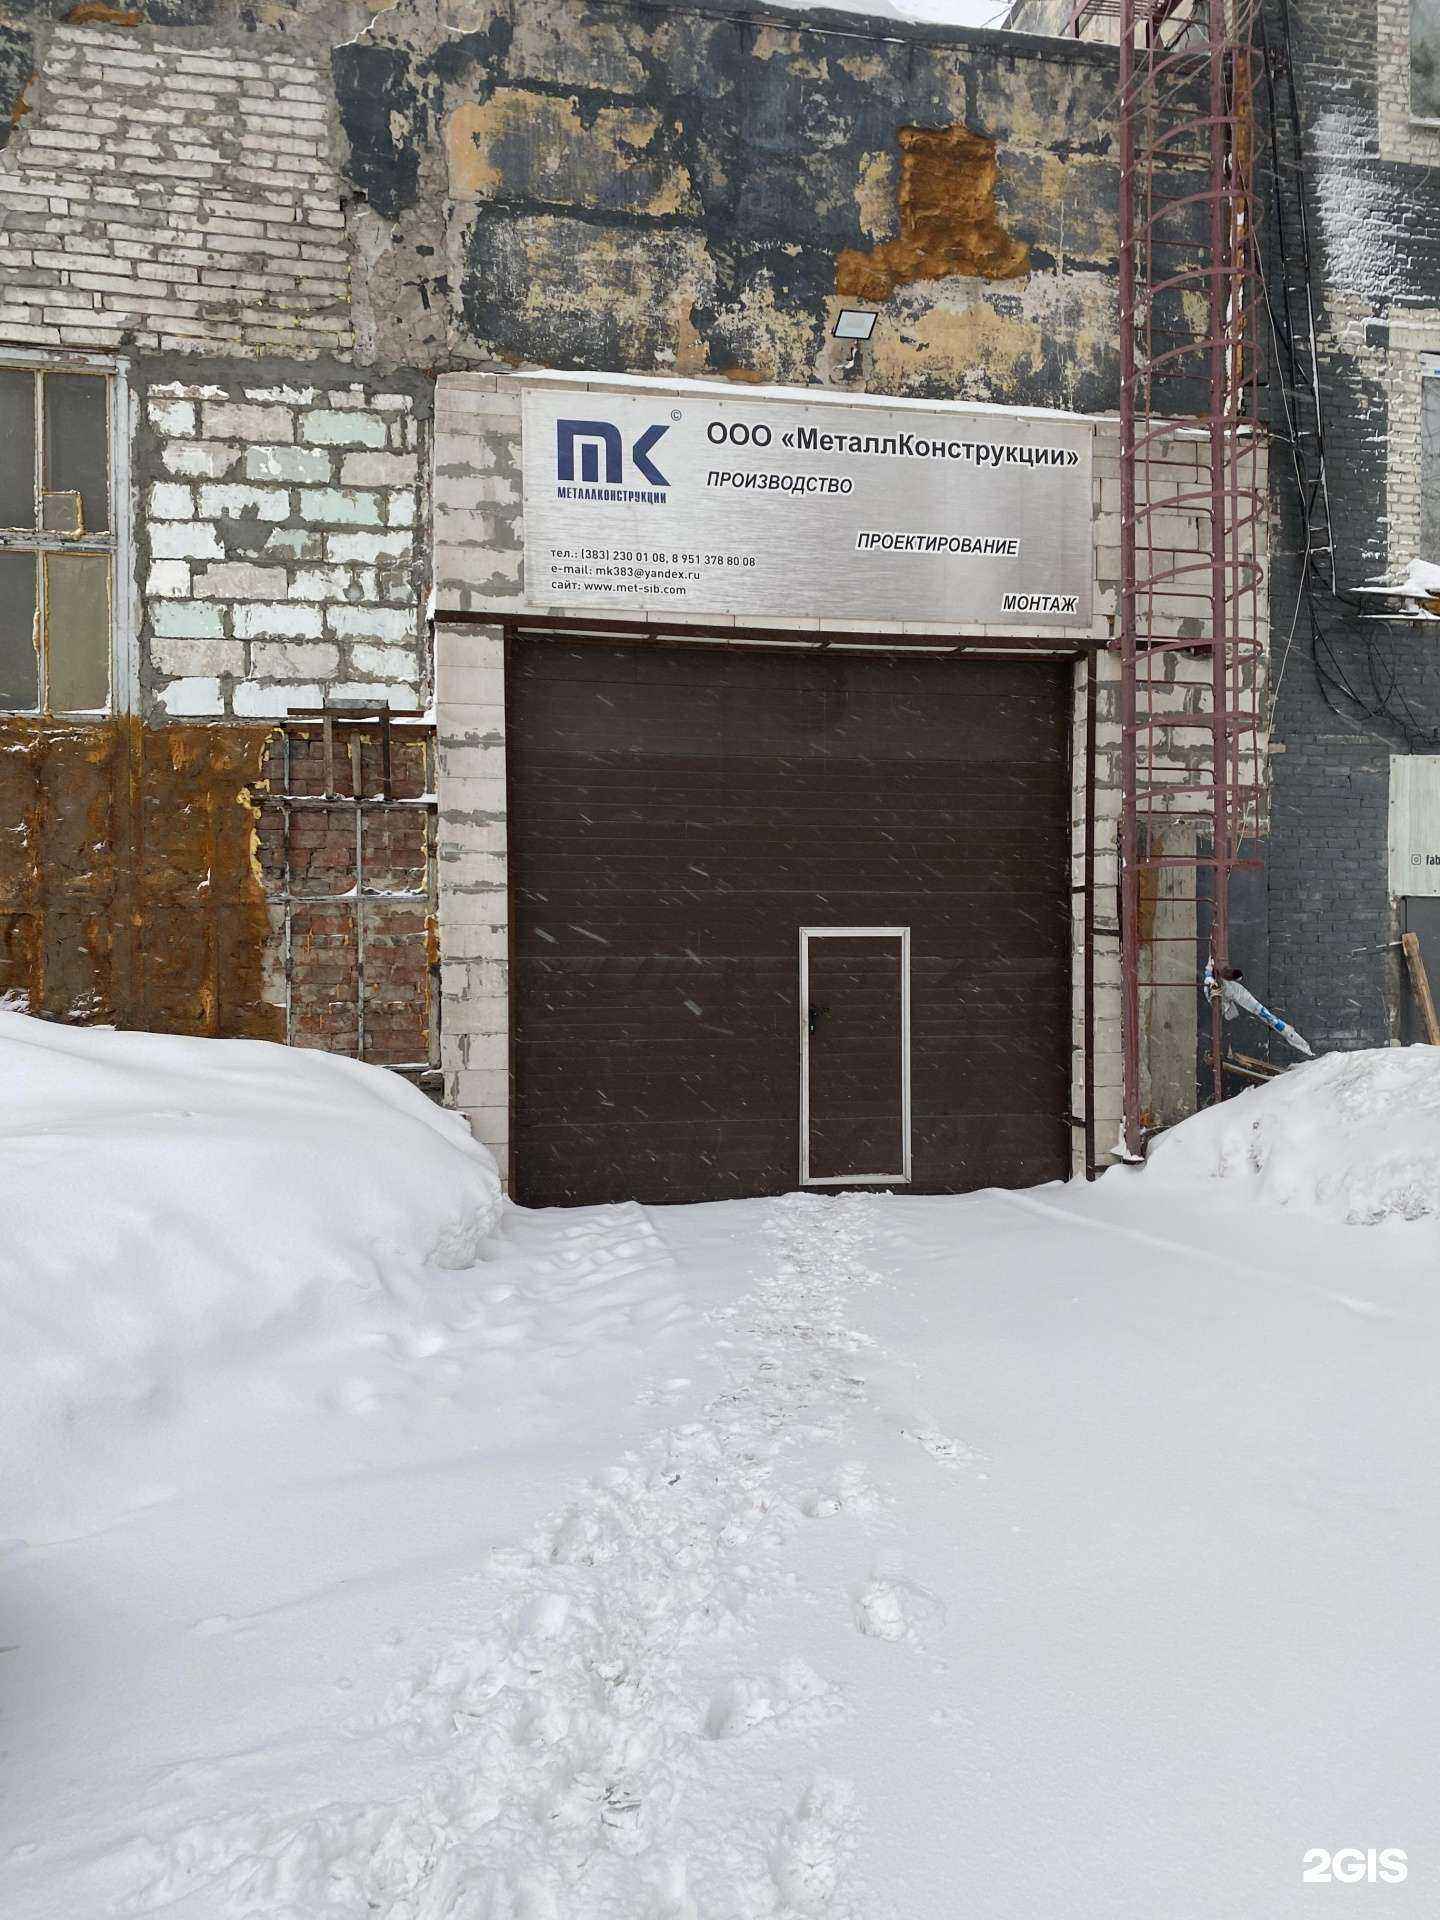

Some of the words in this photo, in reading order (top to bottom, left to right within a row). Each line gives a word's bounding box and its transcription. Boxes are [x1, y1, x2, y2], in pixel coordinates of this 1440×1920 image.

[707, 421, 772, 447] ООО
[781, 426, 1079, 467] «МеталлКонструкции»
[707, 471, 853, 494] ПРОИЗВОДСТВО
[857, 532, 1018, 555] ПРОЕКТИРОВАНИЕ
[550, 549, 578, 559] тел.:
[581, 548, 610, 561] (383)
[613, 550, 633, 561] 230
[636, 552, 648, 562] 01
[652, 552, 669, 563] 08,
[672, 553, 679, 563] 8
[681, 554, 700, 564] 951
[704, 555, 724, 565] 378
[726, 556, 740, 566] 80
[742, 557, 756, 567] 08
[551, 564, 592, 575] e-mail:
[595, 565, 700, 580] mk383@yandex.ru
[551, 580, 581, 590] сайт:
[583, 582, 687, 595] www.met-sib.com
[1002, 595, 1078, 613] МОНТАЖ
